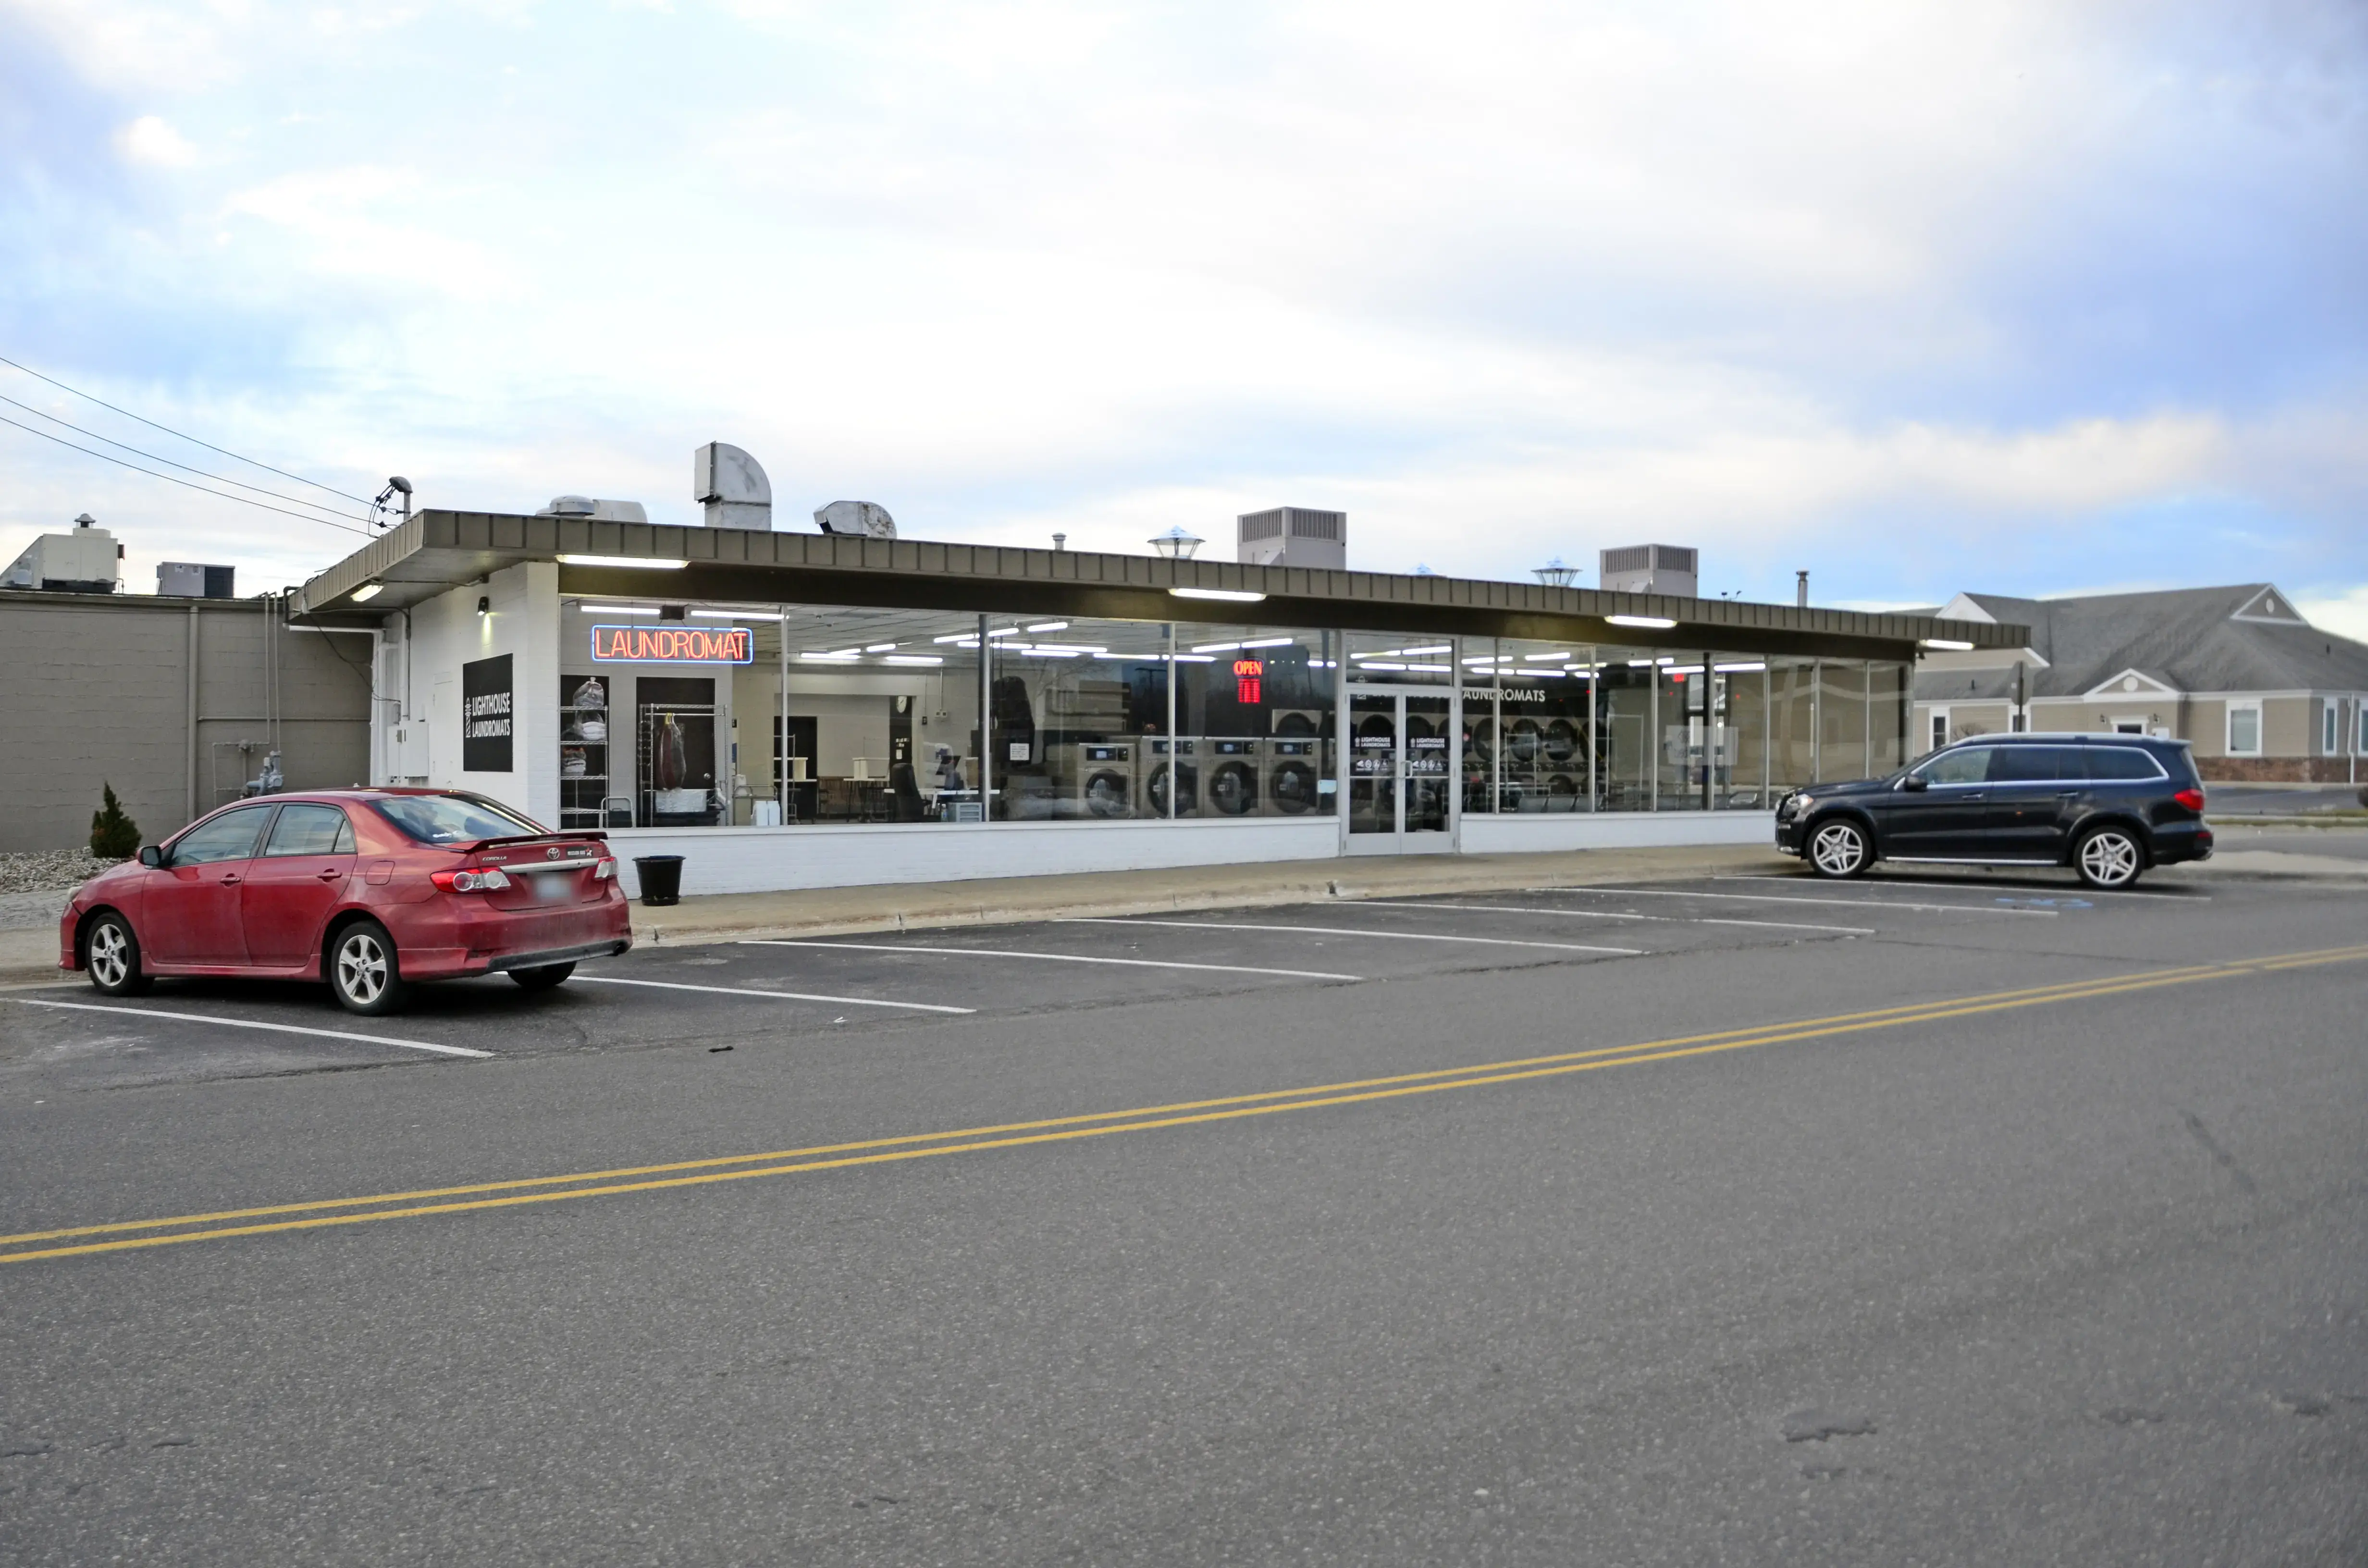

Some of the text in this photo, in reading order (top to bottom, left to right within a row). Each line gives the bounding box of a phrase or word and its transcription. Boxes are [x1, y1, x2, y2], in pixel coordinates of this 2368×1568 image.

[595, 629, 747, 660] LAUNDROMAT
[1233, 661, 1262, 675] OPEN
[472, 692, 510, 716] LIGHTHOUSE
[472, 719, 510, 737] LAUNDROMATS
